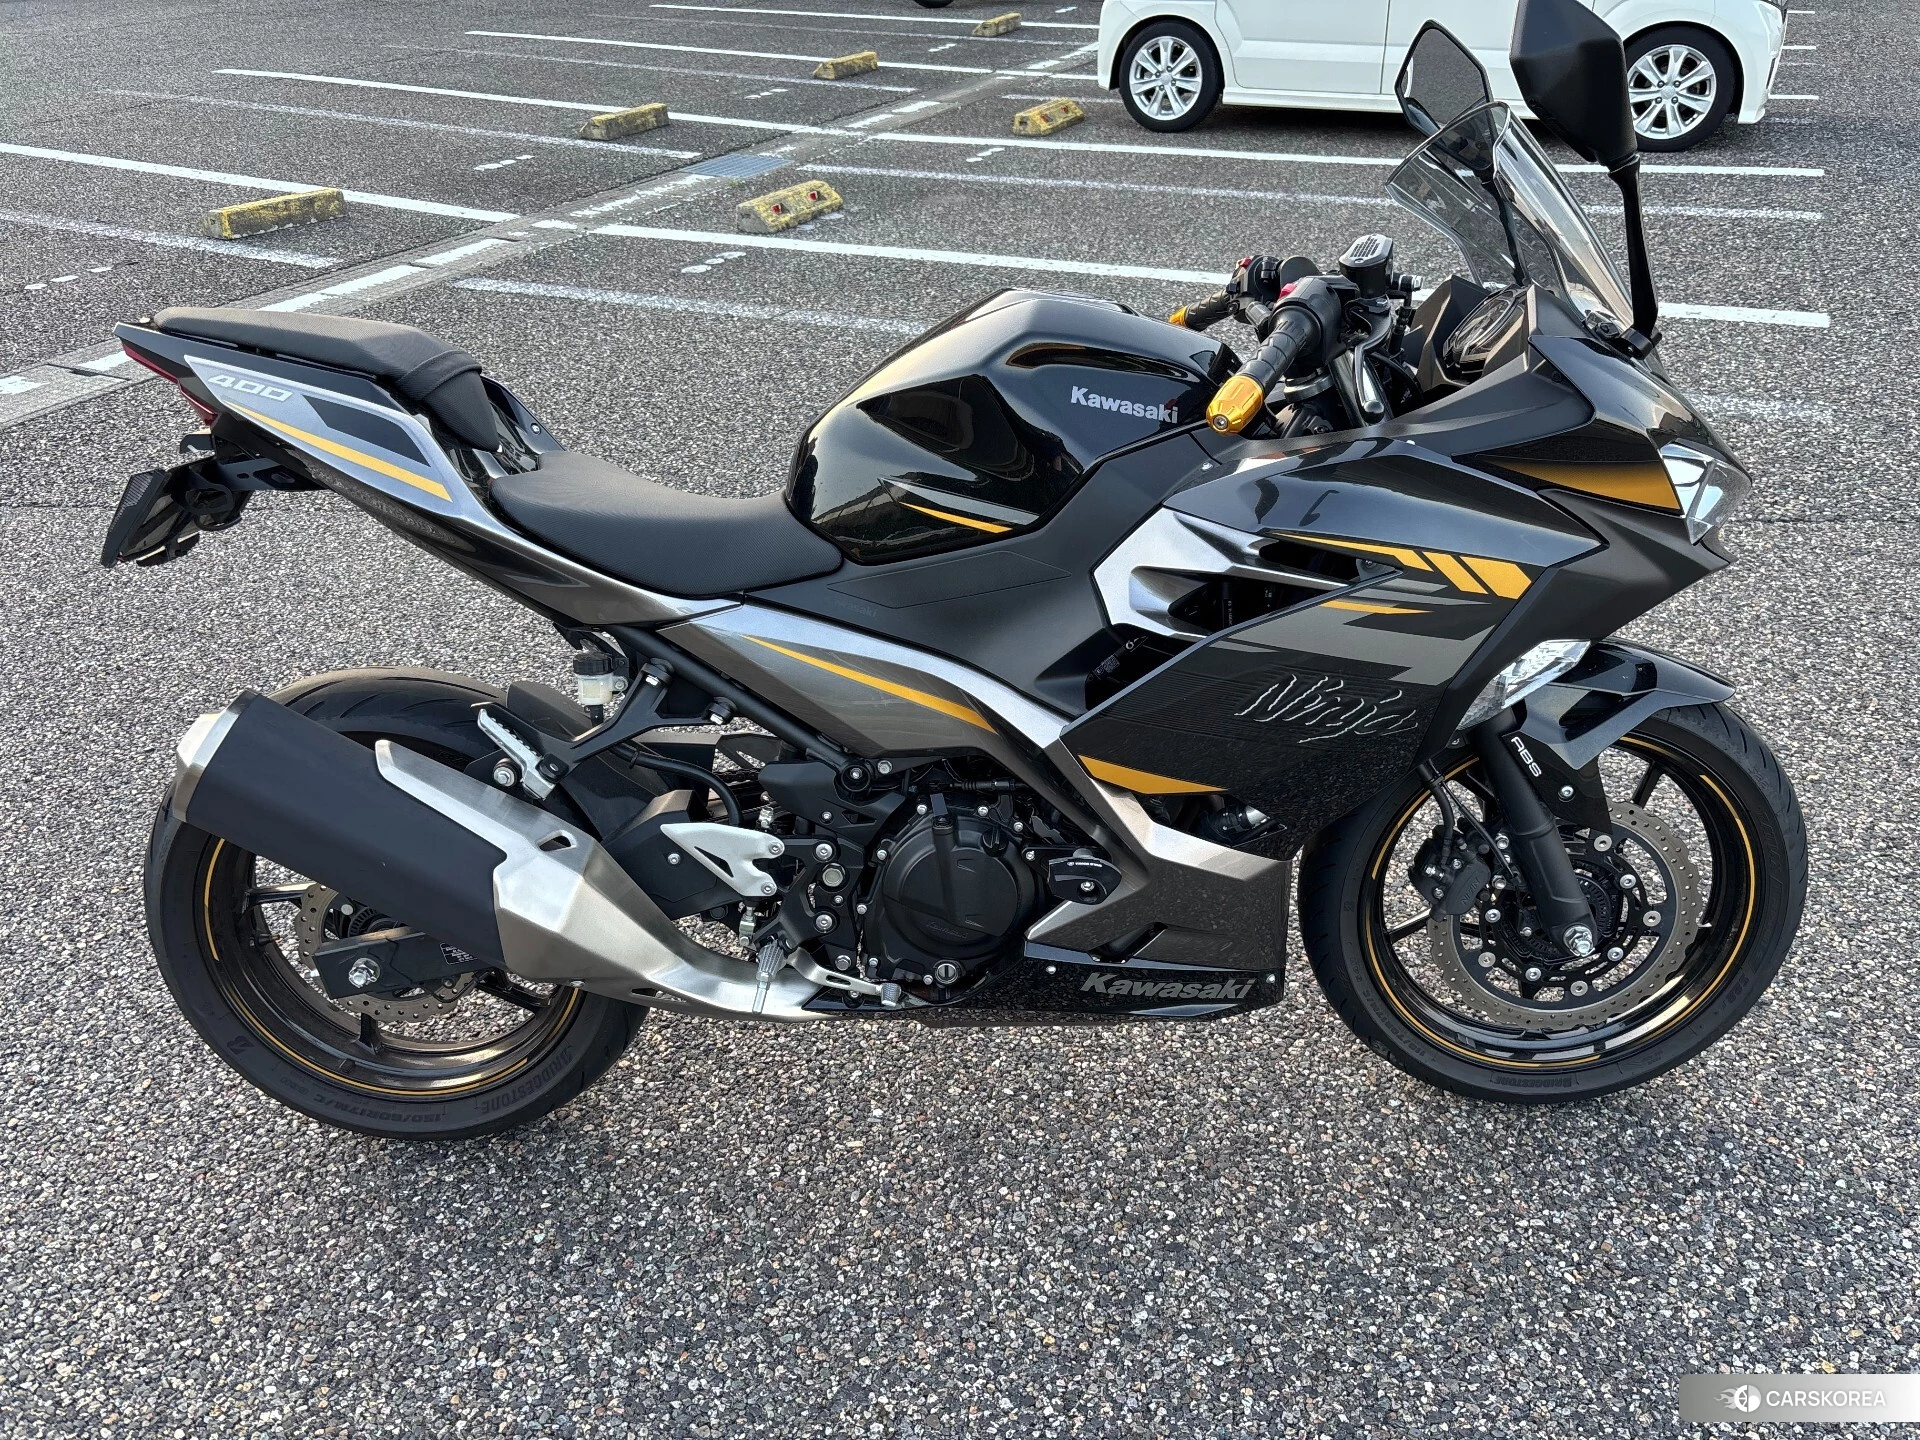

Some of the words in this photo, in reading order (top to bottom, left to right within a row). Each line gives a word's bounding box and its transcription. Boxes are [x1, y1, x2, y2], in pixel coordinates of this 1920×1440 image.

[208, 374, 293, 402] 400
[1070, 385, 1179, 424] Kawasaki
[1233, 673, 1419, 744] Ninja
[1510, 736, 1542, 777] ABS
[1079, 972, 1256, 999] Kawasaki
[480, 1045, 574, 1115] BRIDGESTONE
